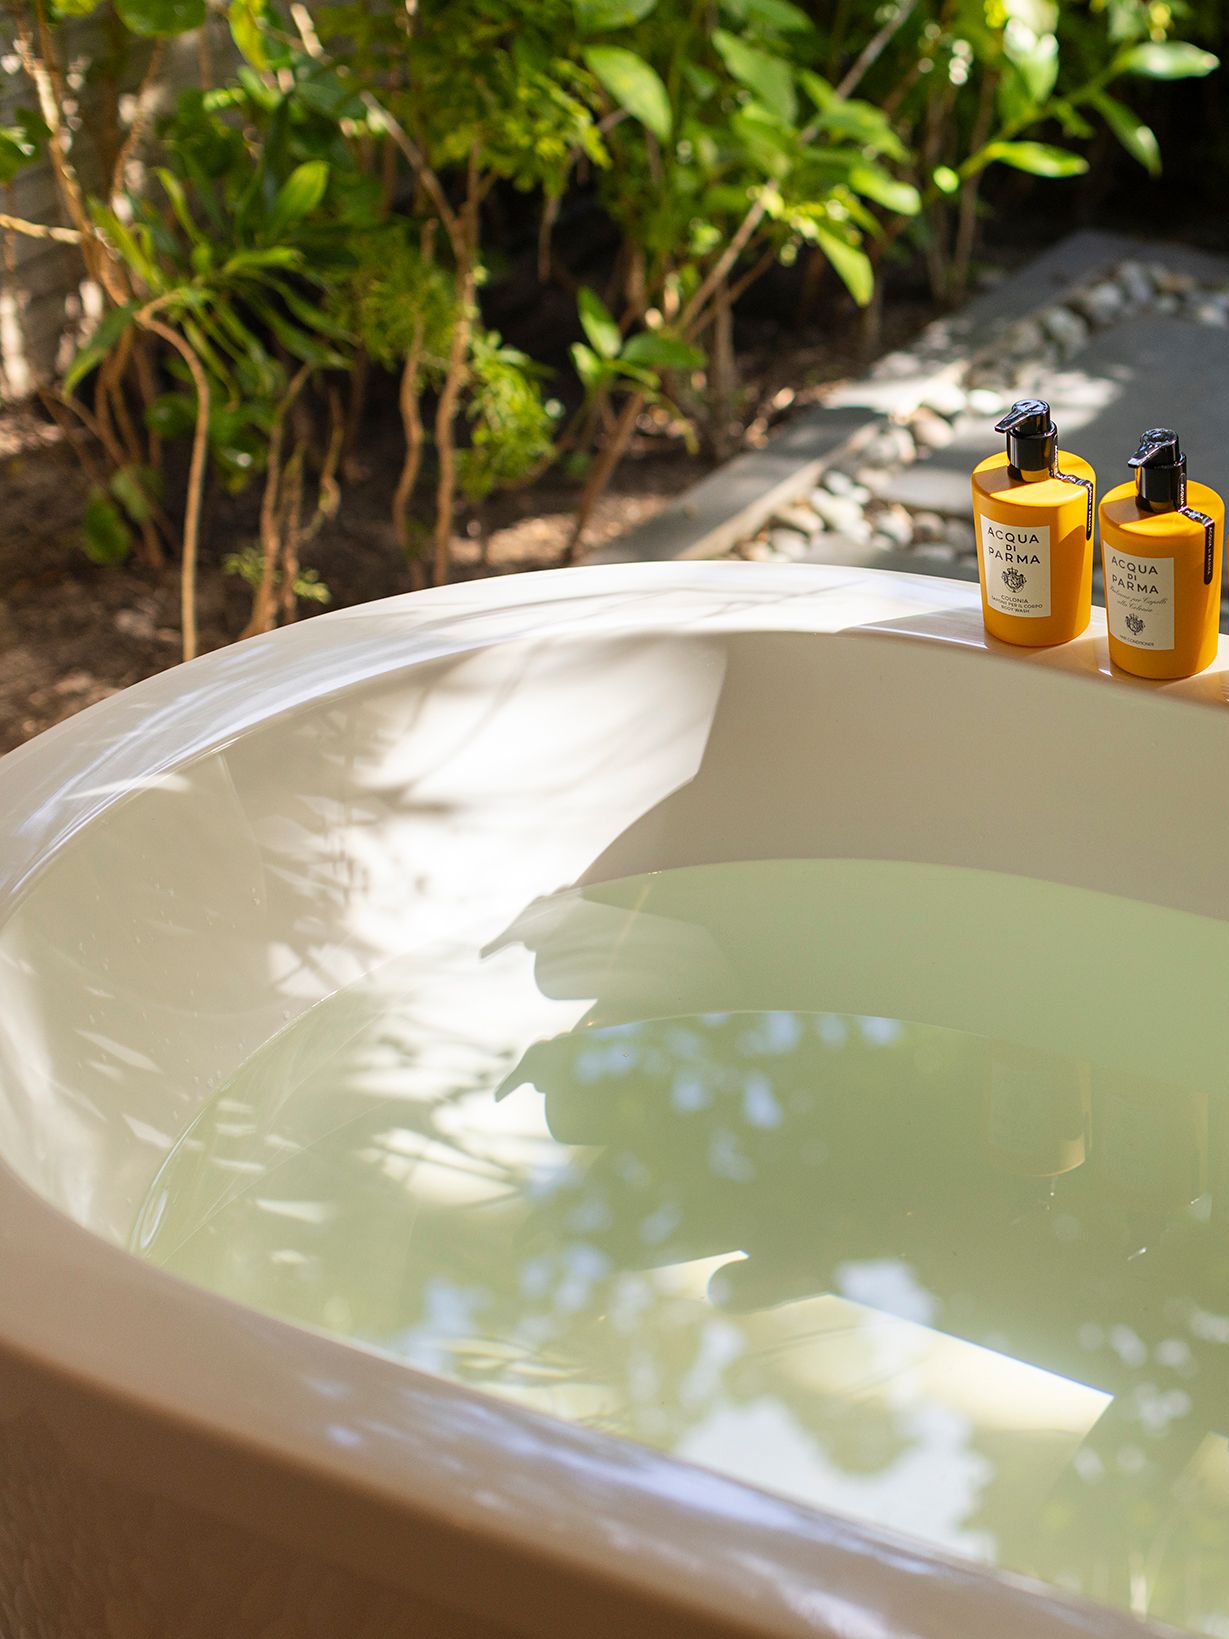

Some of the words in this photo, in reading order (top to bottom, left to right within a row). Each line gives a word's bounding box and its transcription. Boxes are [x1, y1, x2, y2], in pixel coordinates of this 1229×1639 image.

[988, 526, 1040, 544] ACQUA
[988, 546, 1041, 564] PARMA
[1005, 544, 1017, 552] DI
[1111, 555, 1159, 575] ACQUA
[1112, 574, 1159, 594] PARMA
[1127, 573, 1137, 581] DI
[1001, 595, 1029, 604] COLONIA
